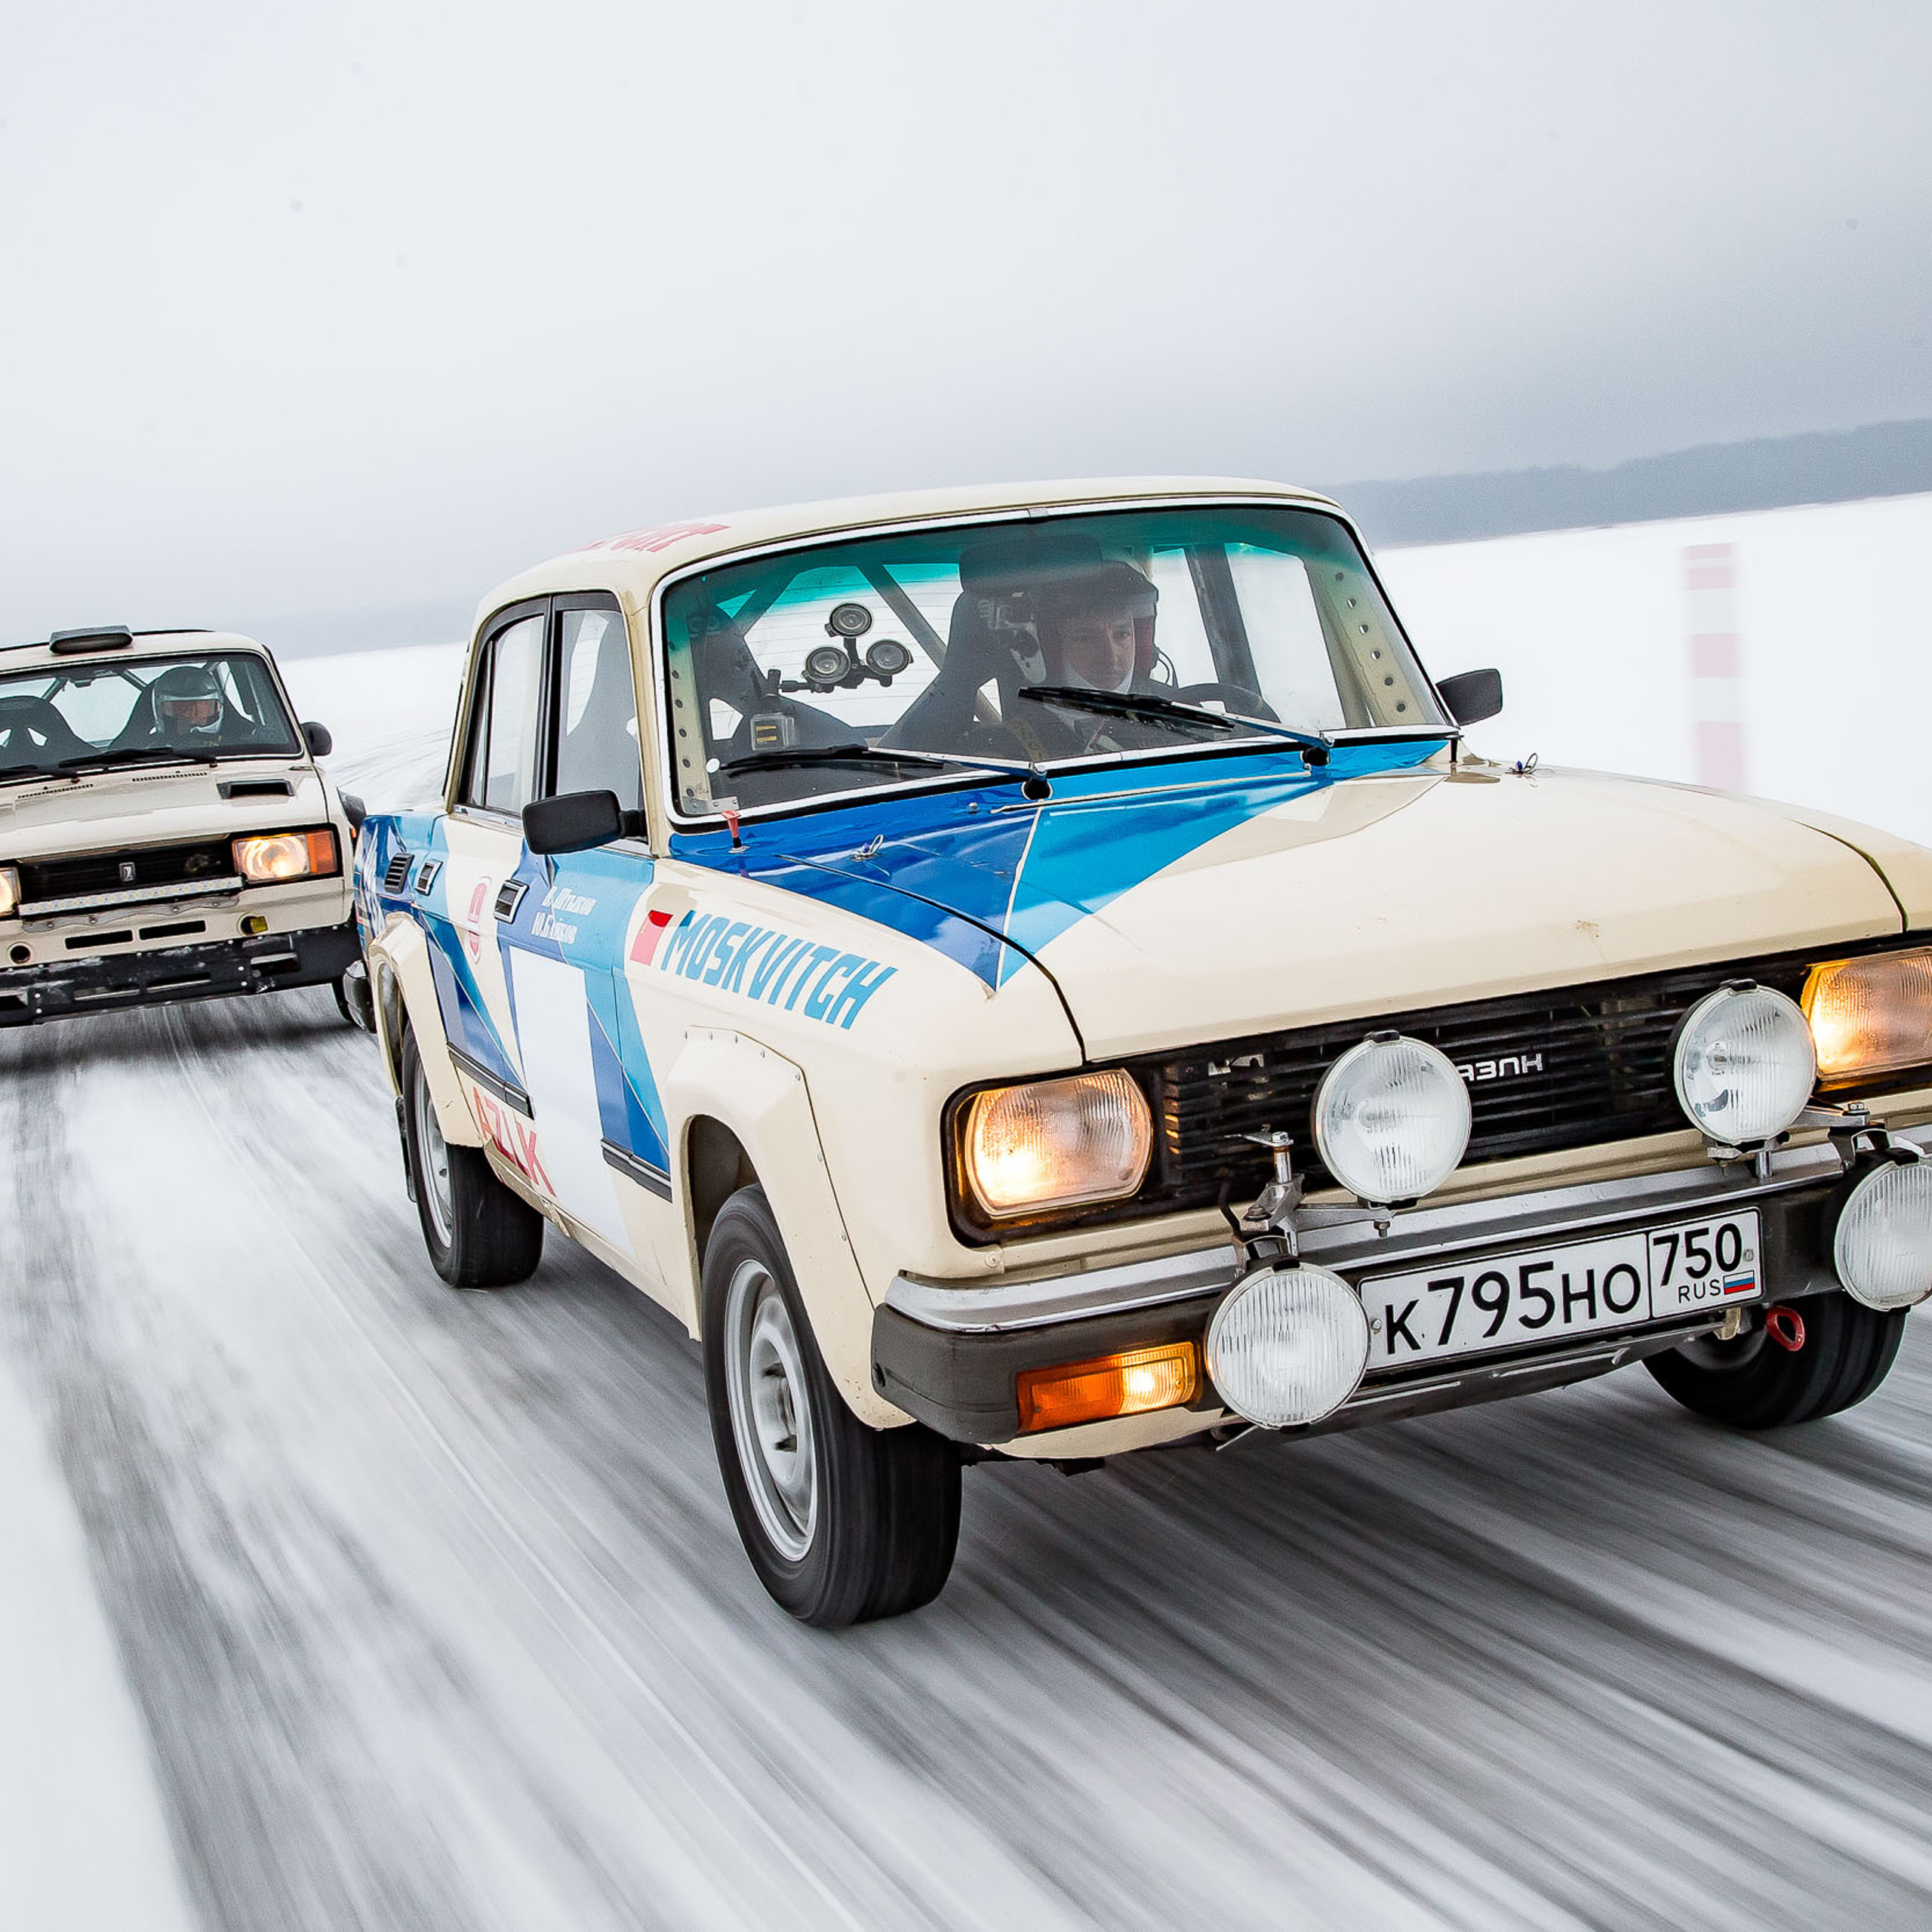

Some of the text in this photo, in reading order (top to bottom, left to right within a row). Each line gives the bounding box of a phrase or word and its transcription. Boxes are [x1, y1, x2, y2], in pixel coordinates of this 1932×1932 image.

[660, 910, 898, 1029] MOSKVITCH
[473, 1087, 557, 1197] AZLK
[1653, 1223, 1742, 1286] 750
[1678, 1278, 1721, 1304] RUS
